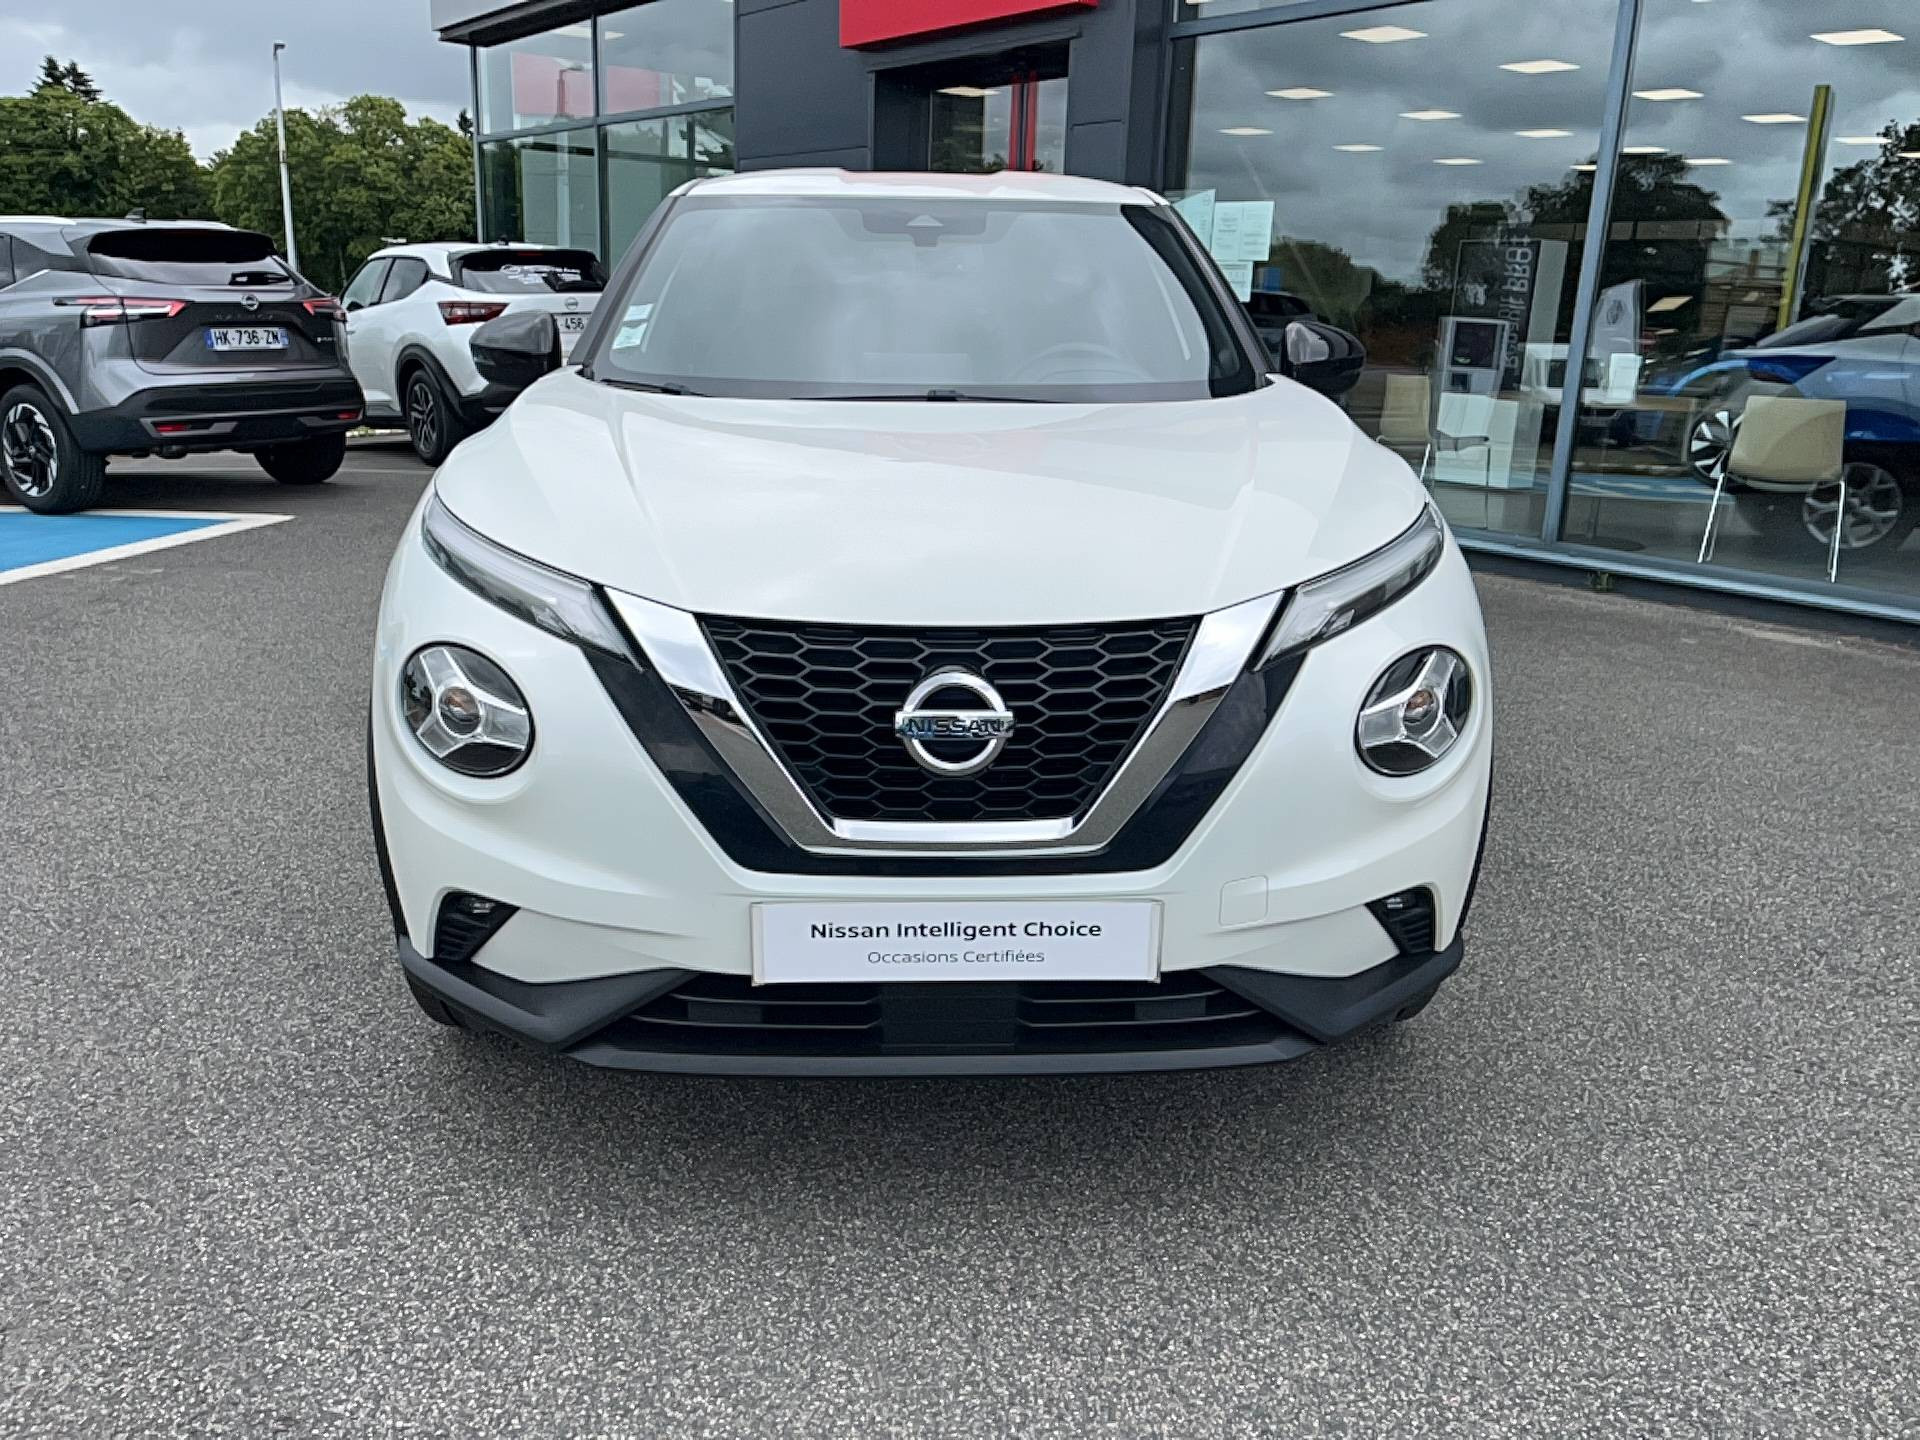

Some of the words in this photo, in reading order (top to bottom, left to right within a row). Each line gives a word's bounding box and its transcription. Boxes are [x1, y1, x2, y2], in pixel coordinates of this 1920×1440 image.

[903, 718, 1004, 737] NISSAN
[810, 922, 889, 939] Nissan
[897, 921, 1017, 941] Intelligent
[1023, 920, 1102, 937] Choice
[867, 951, 959, 964] Occasions
[963, 949, 1045, 963] Certifiées
